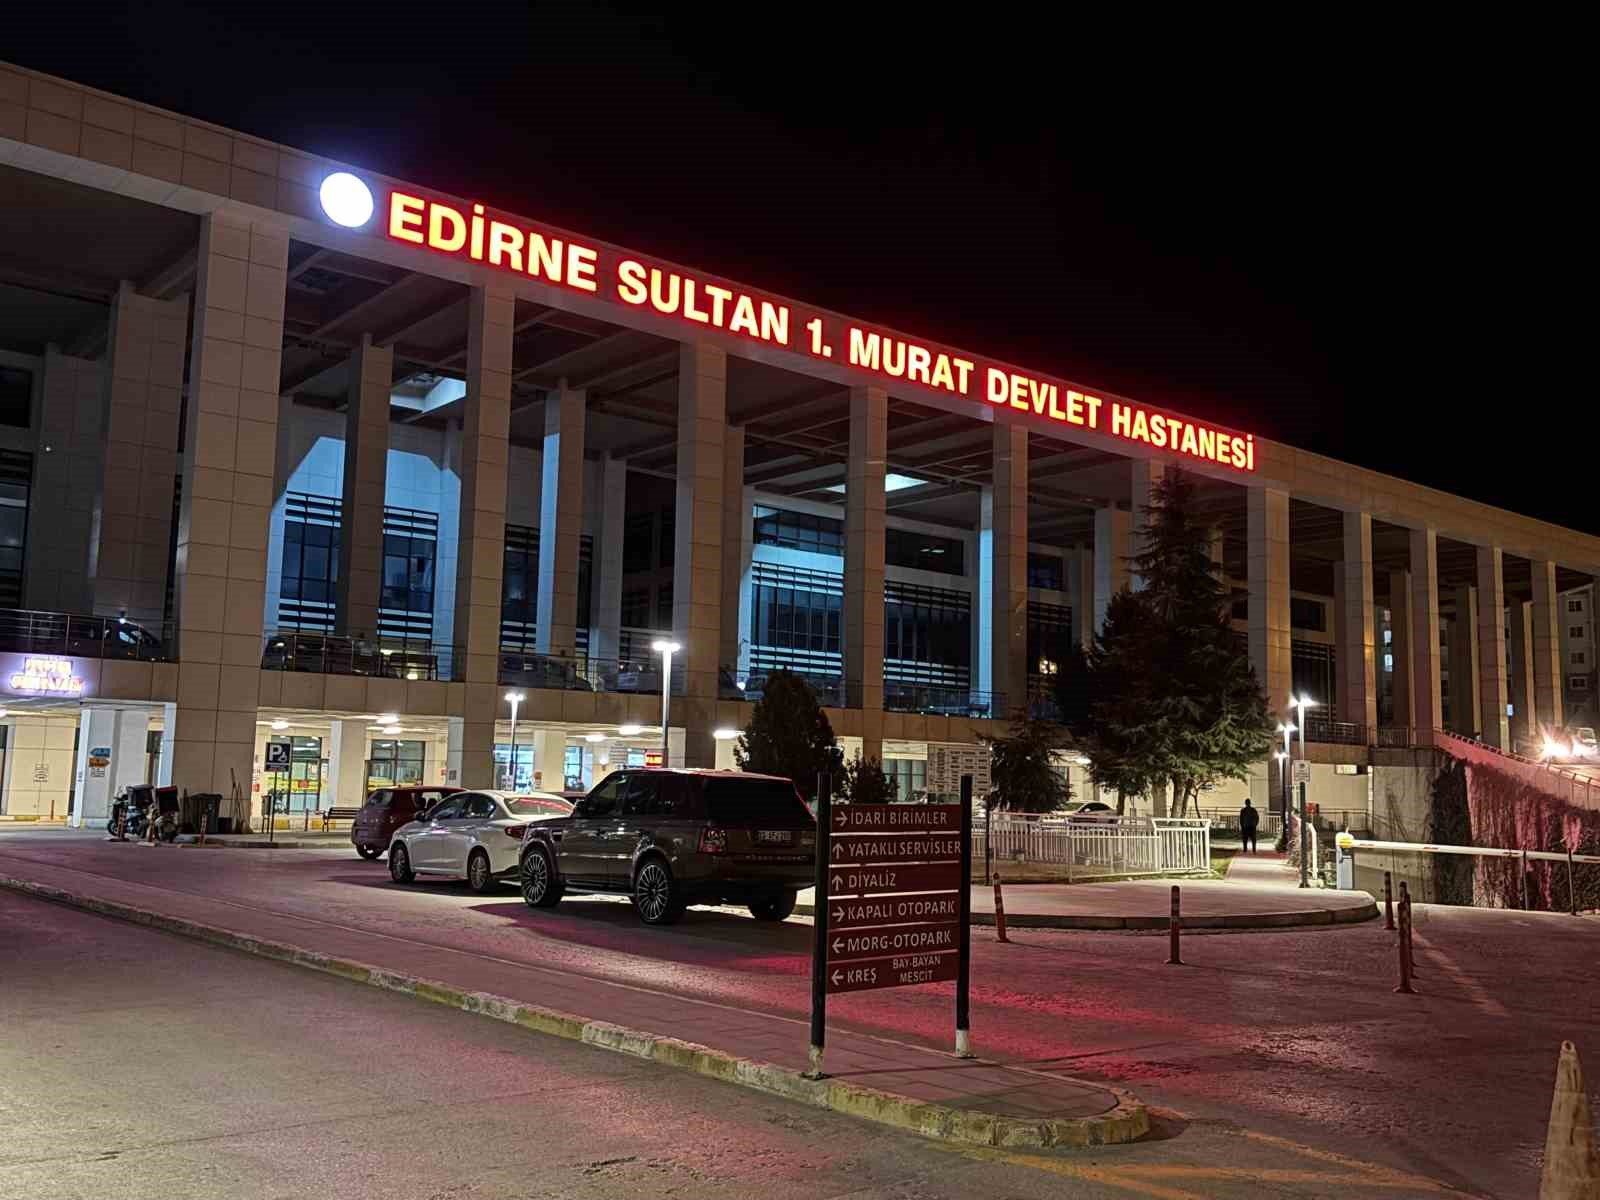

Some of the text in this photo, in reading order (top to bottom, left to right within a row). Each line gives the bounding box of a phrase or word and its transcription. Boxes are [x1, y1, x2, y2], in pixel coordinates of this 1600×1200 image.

[388, 191, 1255, 471] EDİRNE SULTAN 1. MURAT DEVLET HASTANESİ
[850, 807, 948, 825] İDARİ BİRİMLER
[848, 837, 961, 857] YATAKLI SERVİSLER
[848, 868, 897, 889] DİYALİZ
[847, 900, 955, 920] KAPALI OTOPARK
[847, 929, 952, 952] MORG-OTOPARK
[847, 967, 877, 984] KREŞ
